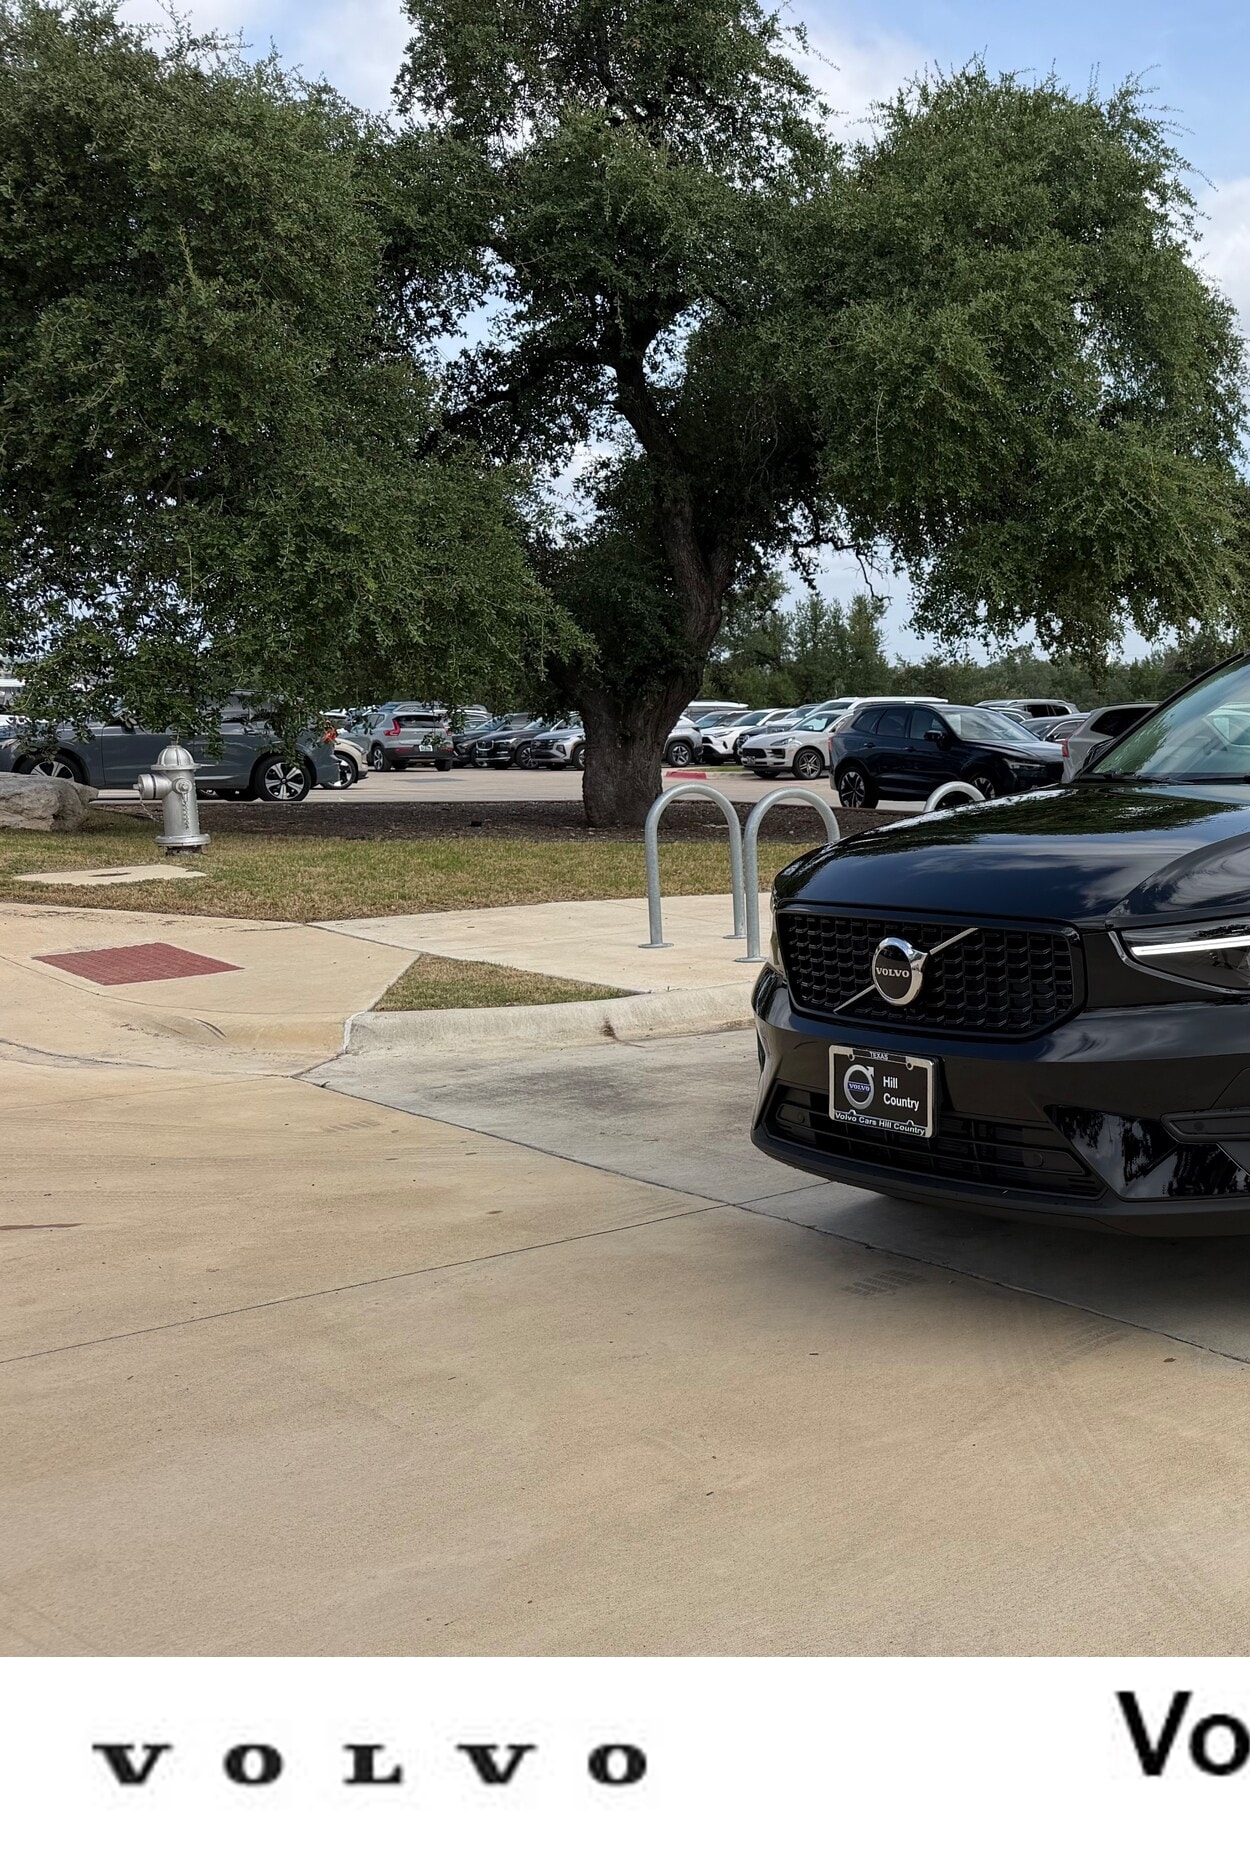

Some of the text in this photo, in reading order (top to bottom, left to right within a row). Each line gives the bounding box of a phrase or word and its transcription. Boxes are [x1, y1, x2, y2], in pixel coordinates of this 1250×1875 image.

[876, 967, 910, 978] VOLVO
[870, 1051, 889, 1060] TEXAS
[848, 1083, 870, 1092] VOLVO
[883, 1076, 898, 1089] Hill
[883, 1093, 920, 1112] Country
[835, 1112, 925, 1136] Volvo Cars Hill Country
